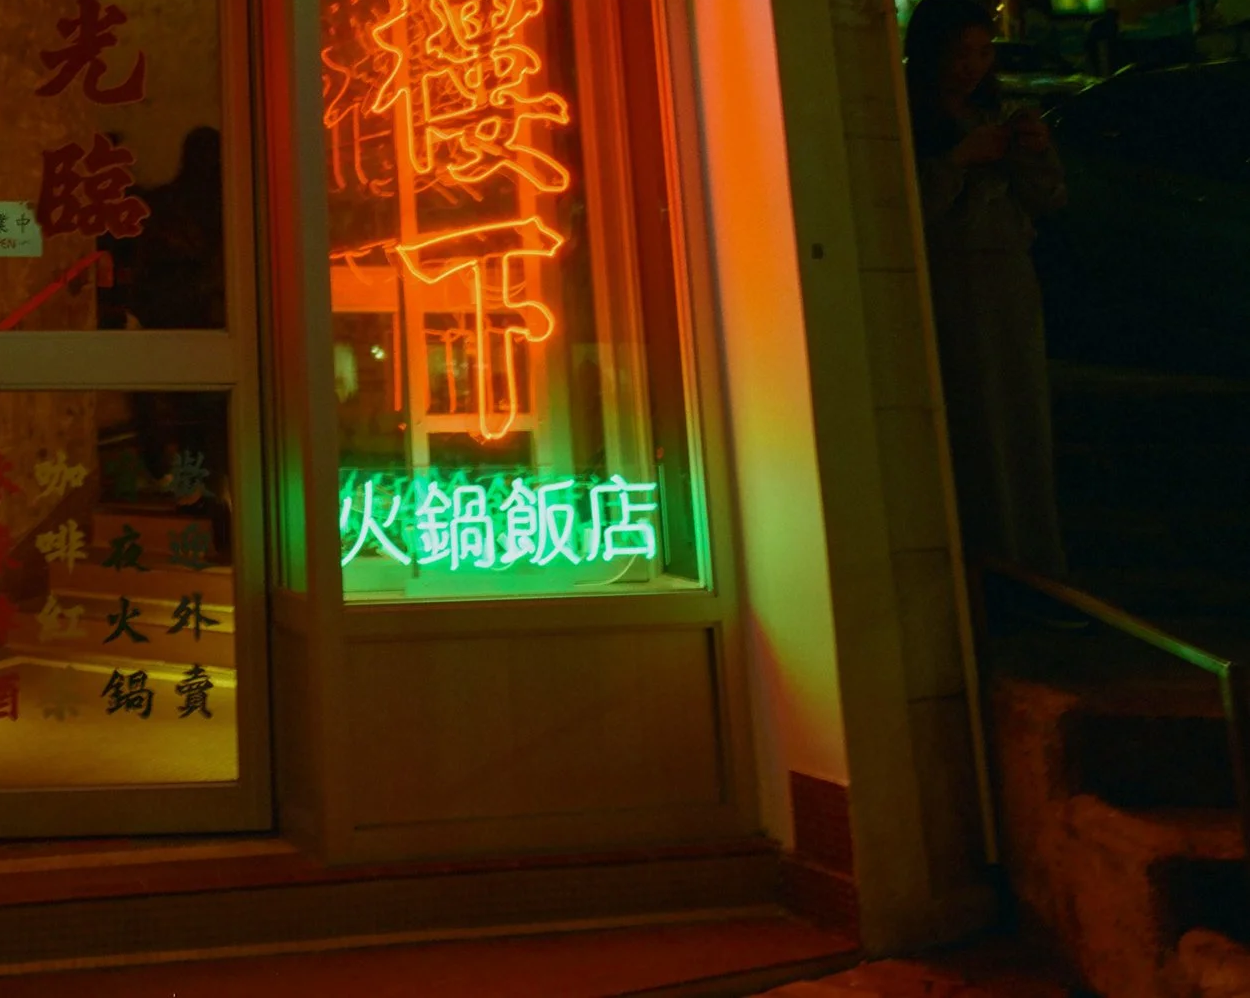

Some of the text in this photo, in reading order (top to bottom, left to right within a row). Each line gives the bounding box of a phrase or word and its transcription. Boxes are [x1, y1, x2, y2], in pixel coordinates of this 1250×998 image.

[100, 449, 155, 720] 夜火鍋
[338, 474, 658, 571] 火鍋飯店
